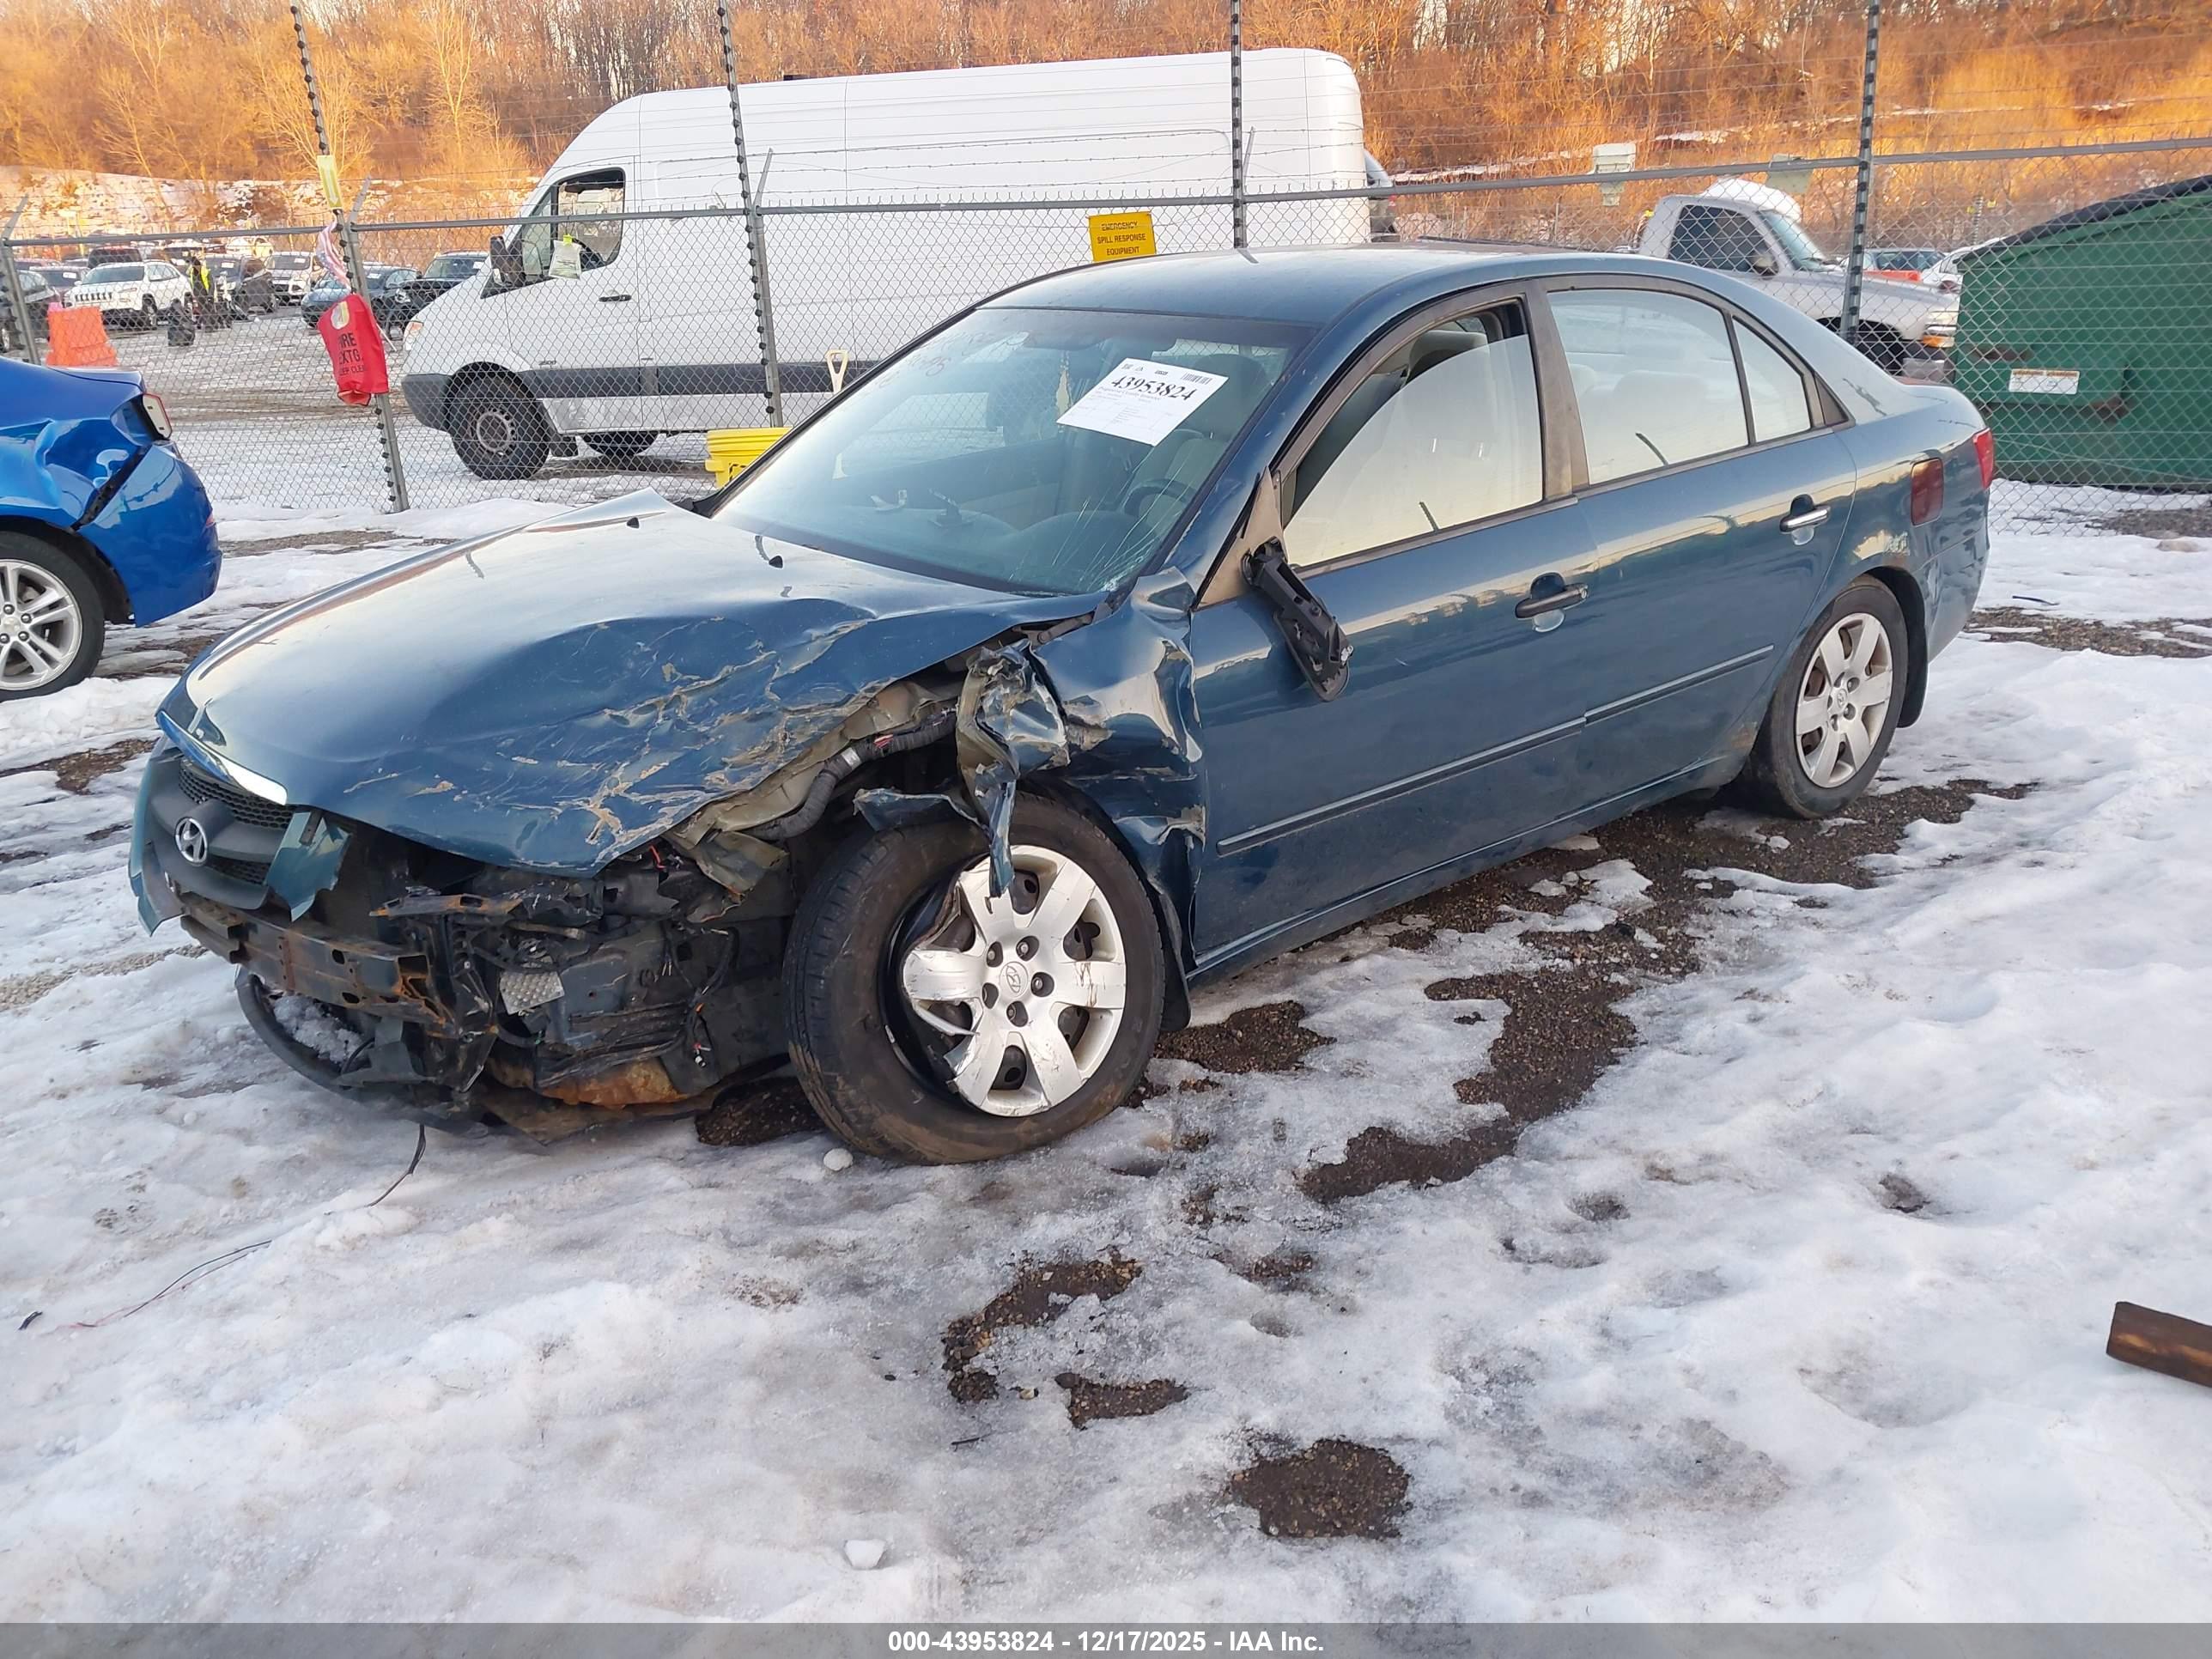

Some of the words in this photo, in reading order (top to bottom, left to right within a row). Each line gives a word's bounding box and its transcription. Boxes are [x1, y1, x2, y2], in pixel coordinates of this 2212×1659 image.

[1101, 222, 1138, 231] EMERGENCY
[1114, 233, 1146, 242] RESPONSE
[1106, 246, 1139, 255] EQUIPMENT
[1111, 375, 1197, 400] 43953824
